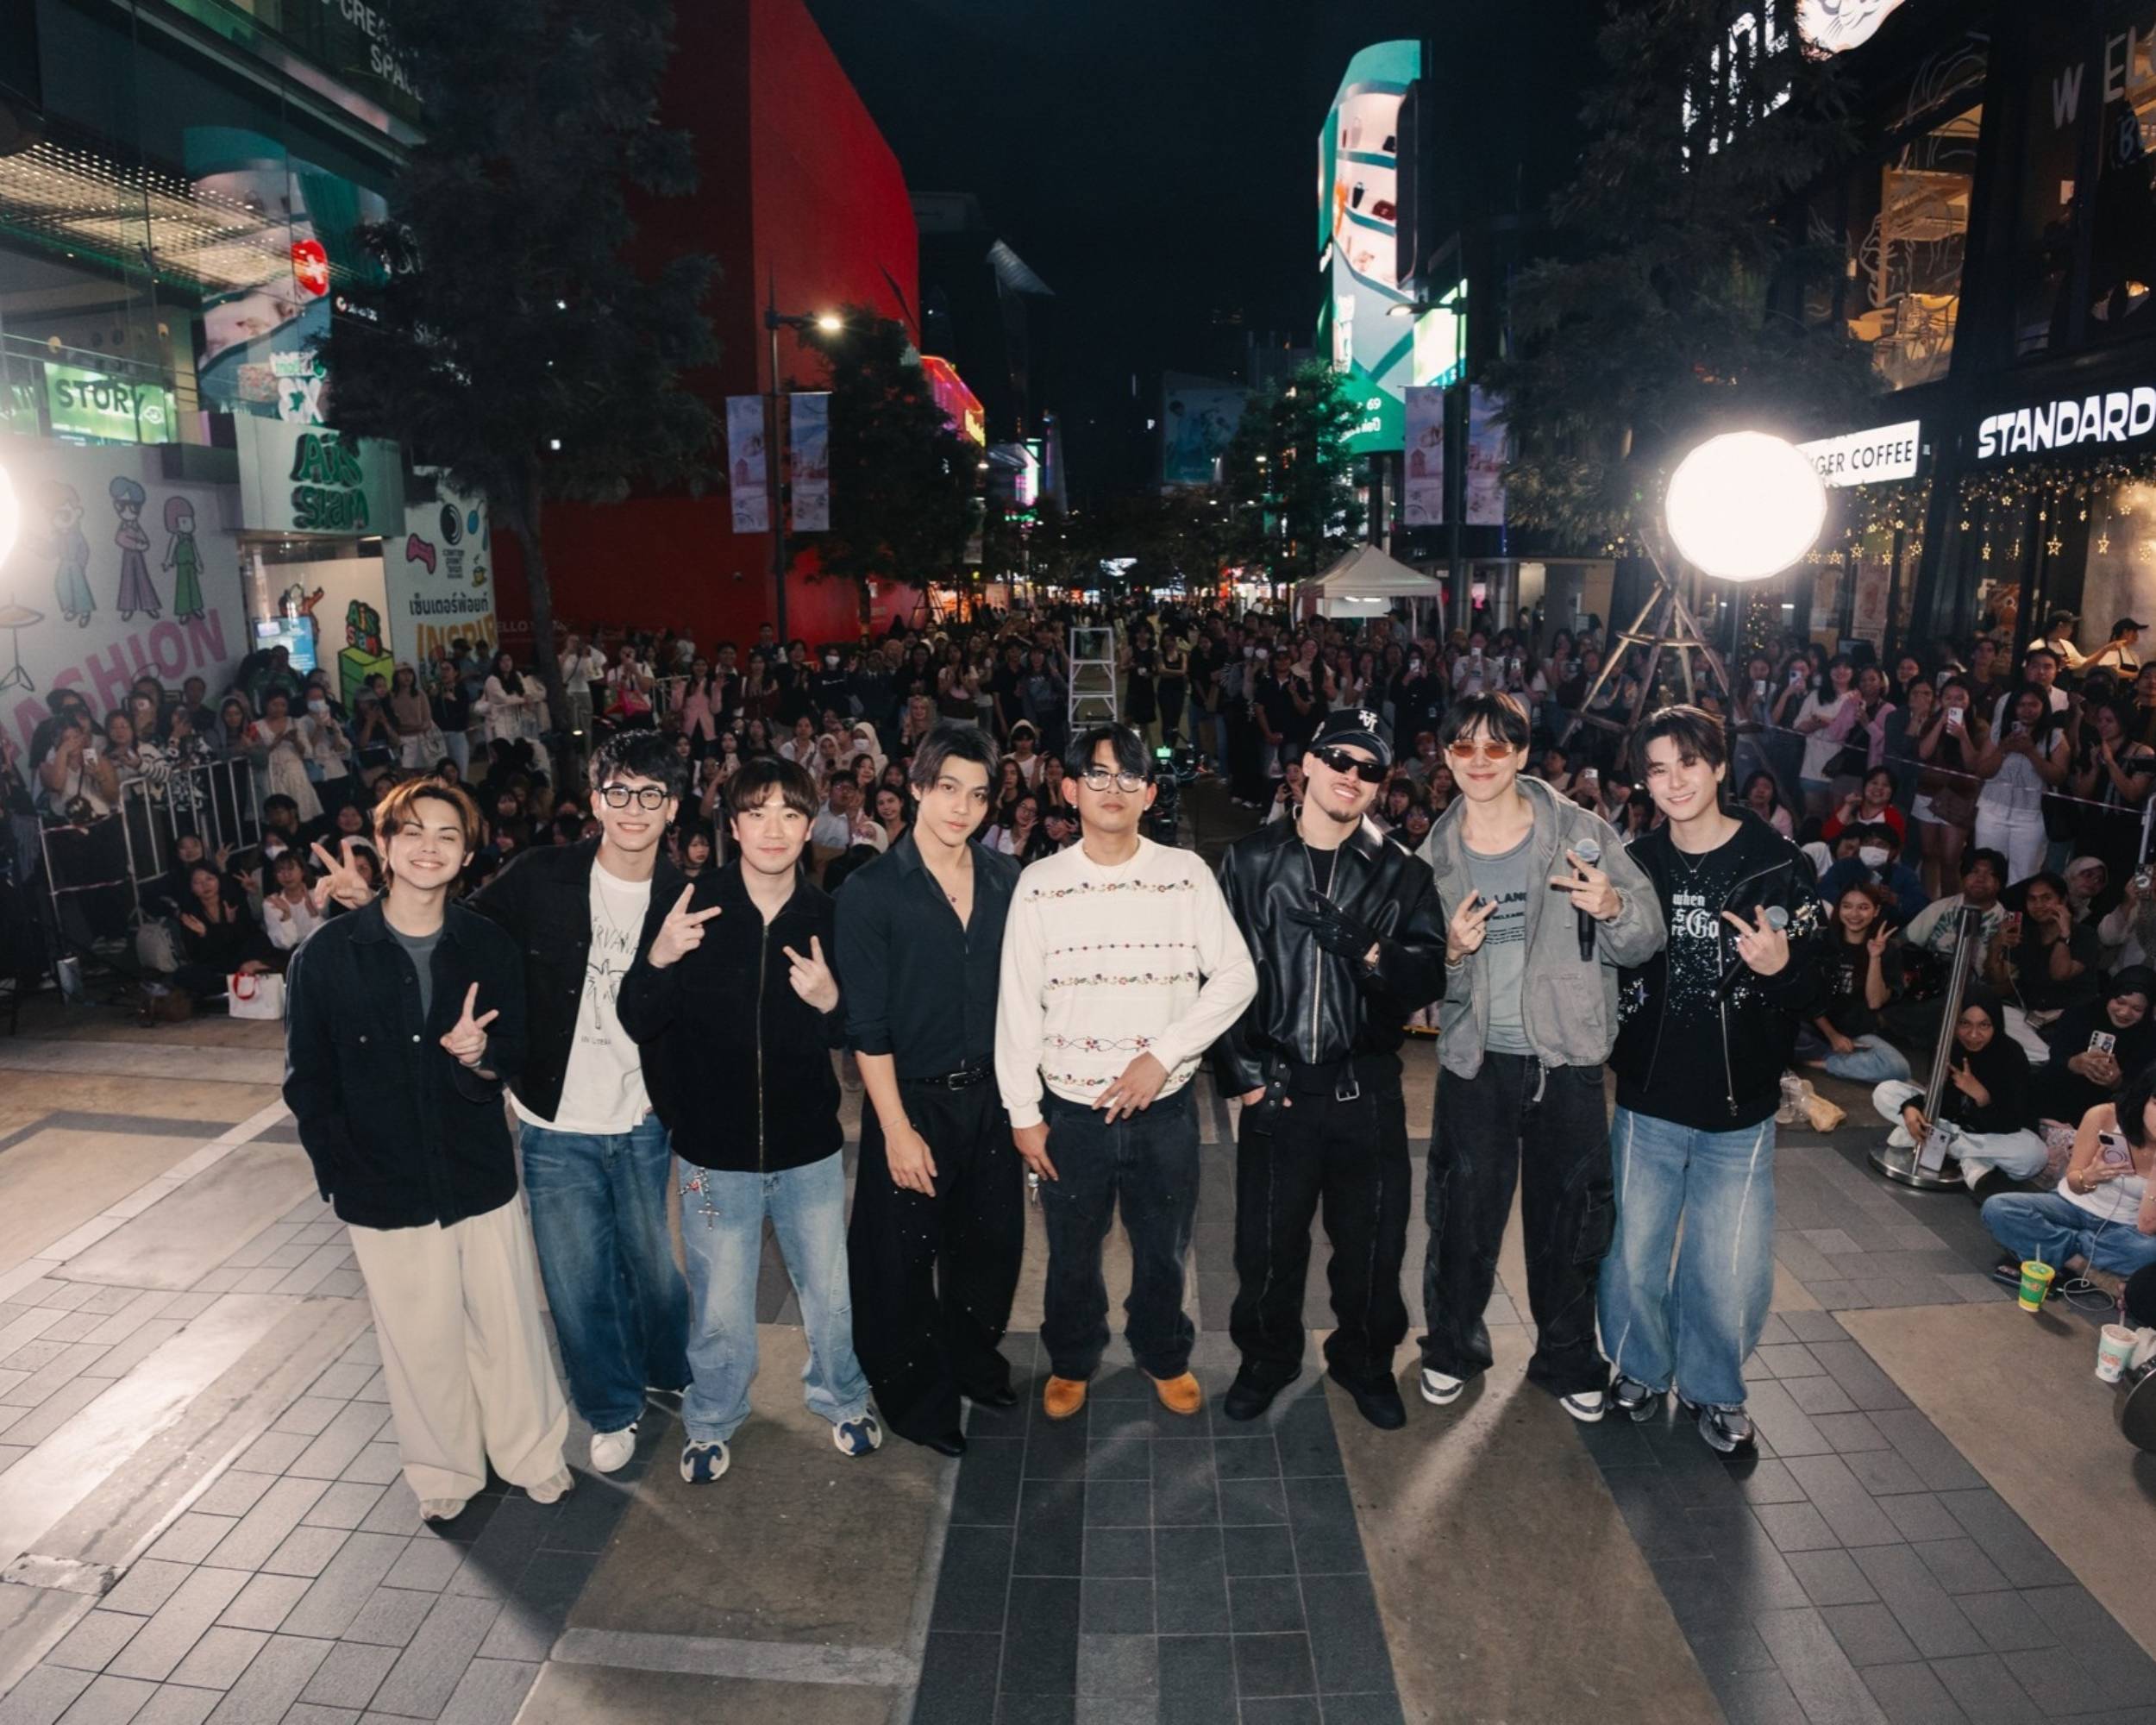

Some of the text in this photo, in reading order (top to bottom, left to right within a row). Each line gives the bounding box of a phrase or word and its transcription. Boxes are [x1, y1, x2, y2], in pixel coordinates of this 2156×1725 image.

[55, 379, 145, 419] STORY
[1977, 386, 2156, 459] STANDARD
[1811, 440, 1914, 476] GER COFFEE
